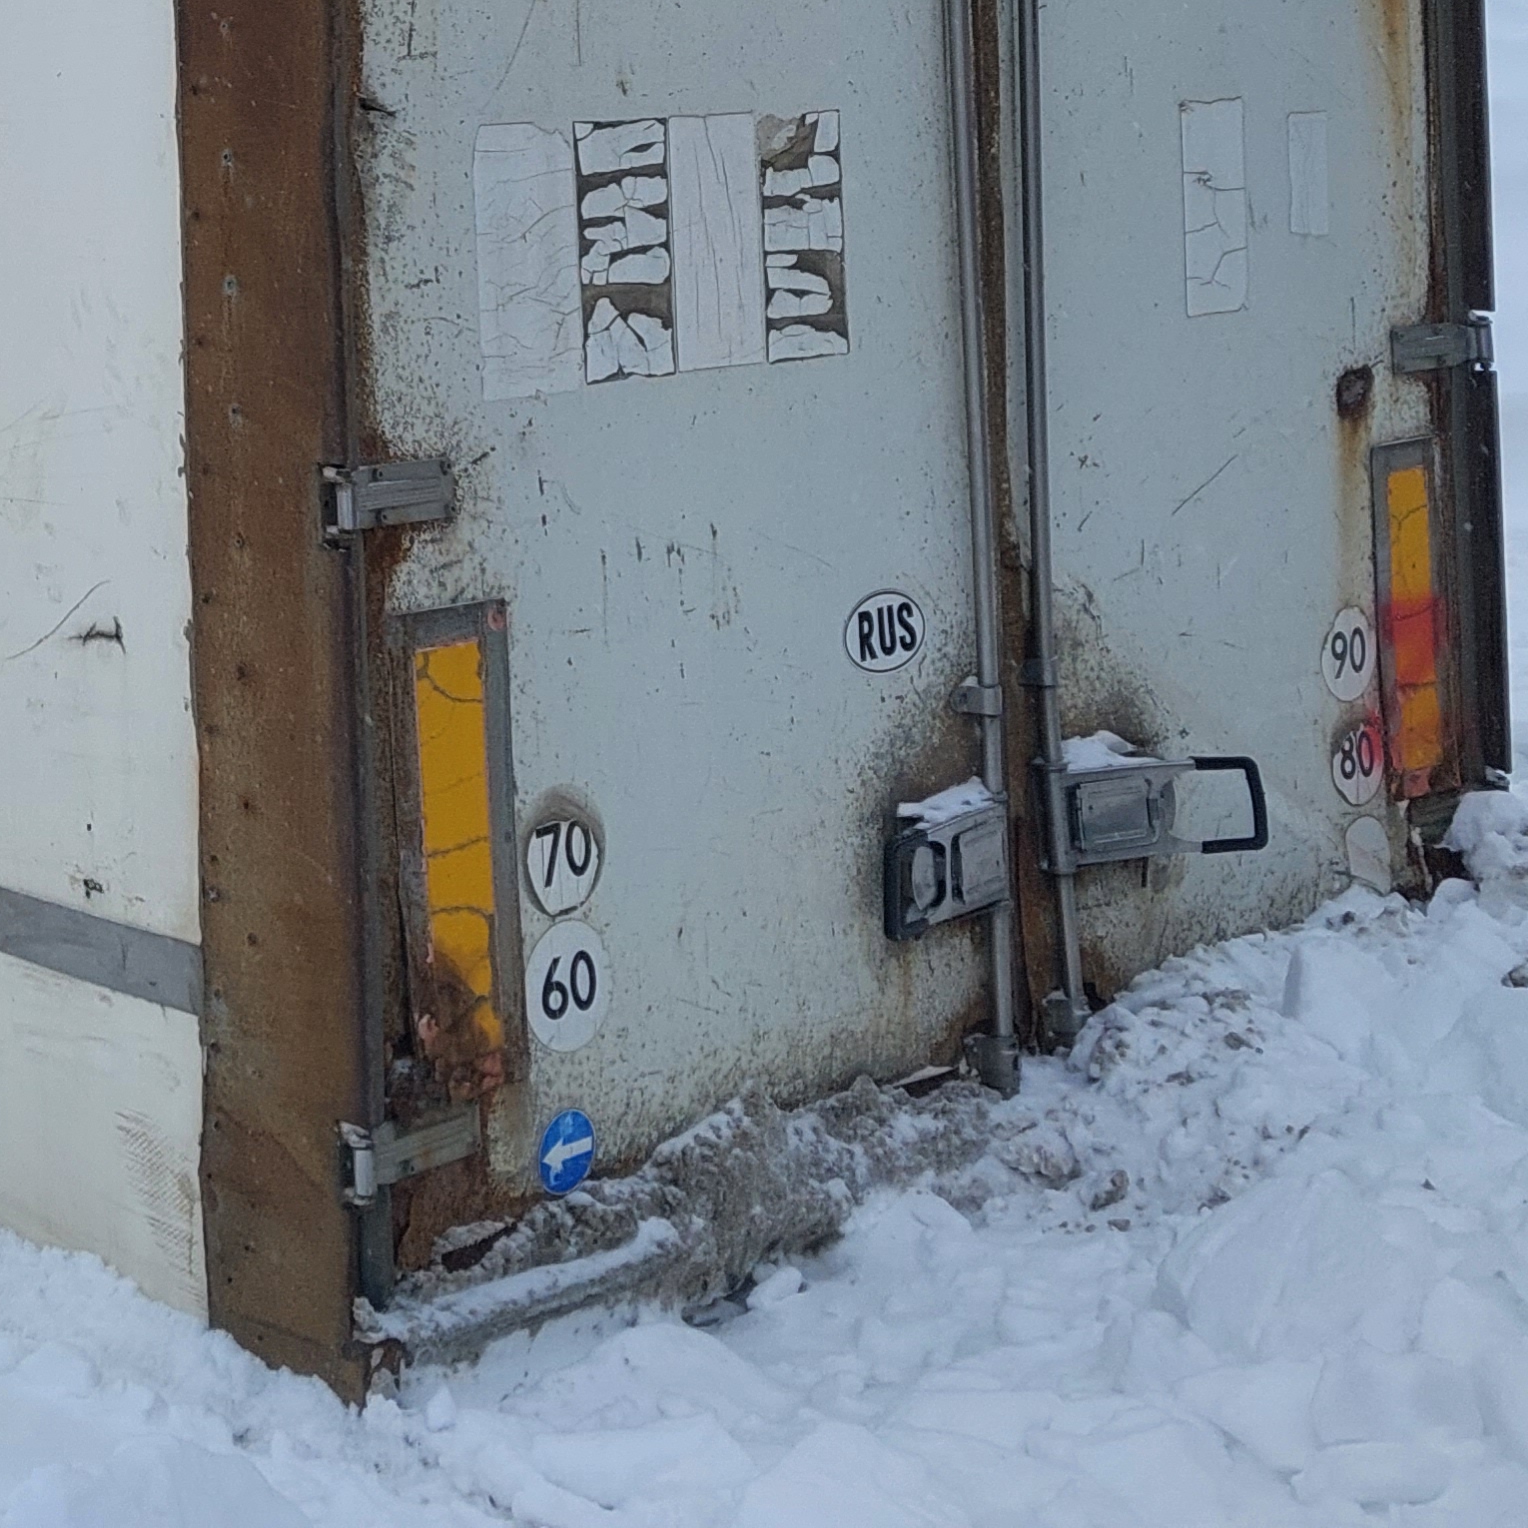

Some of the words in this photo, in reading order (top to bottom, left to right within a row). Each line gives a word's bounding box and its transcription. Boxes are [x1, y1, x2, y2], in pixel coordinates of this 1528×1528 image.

[857, 601, 917, 663] RUS
[1330, 625, 1366, 680] 90
[1339, 730, 1374, 781] 80
[535, 819, 592, 889] 70
[541, 949, 597, 1021] 60
